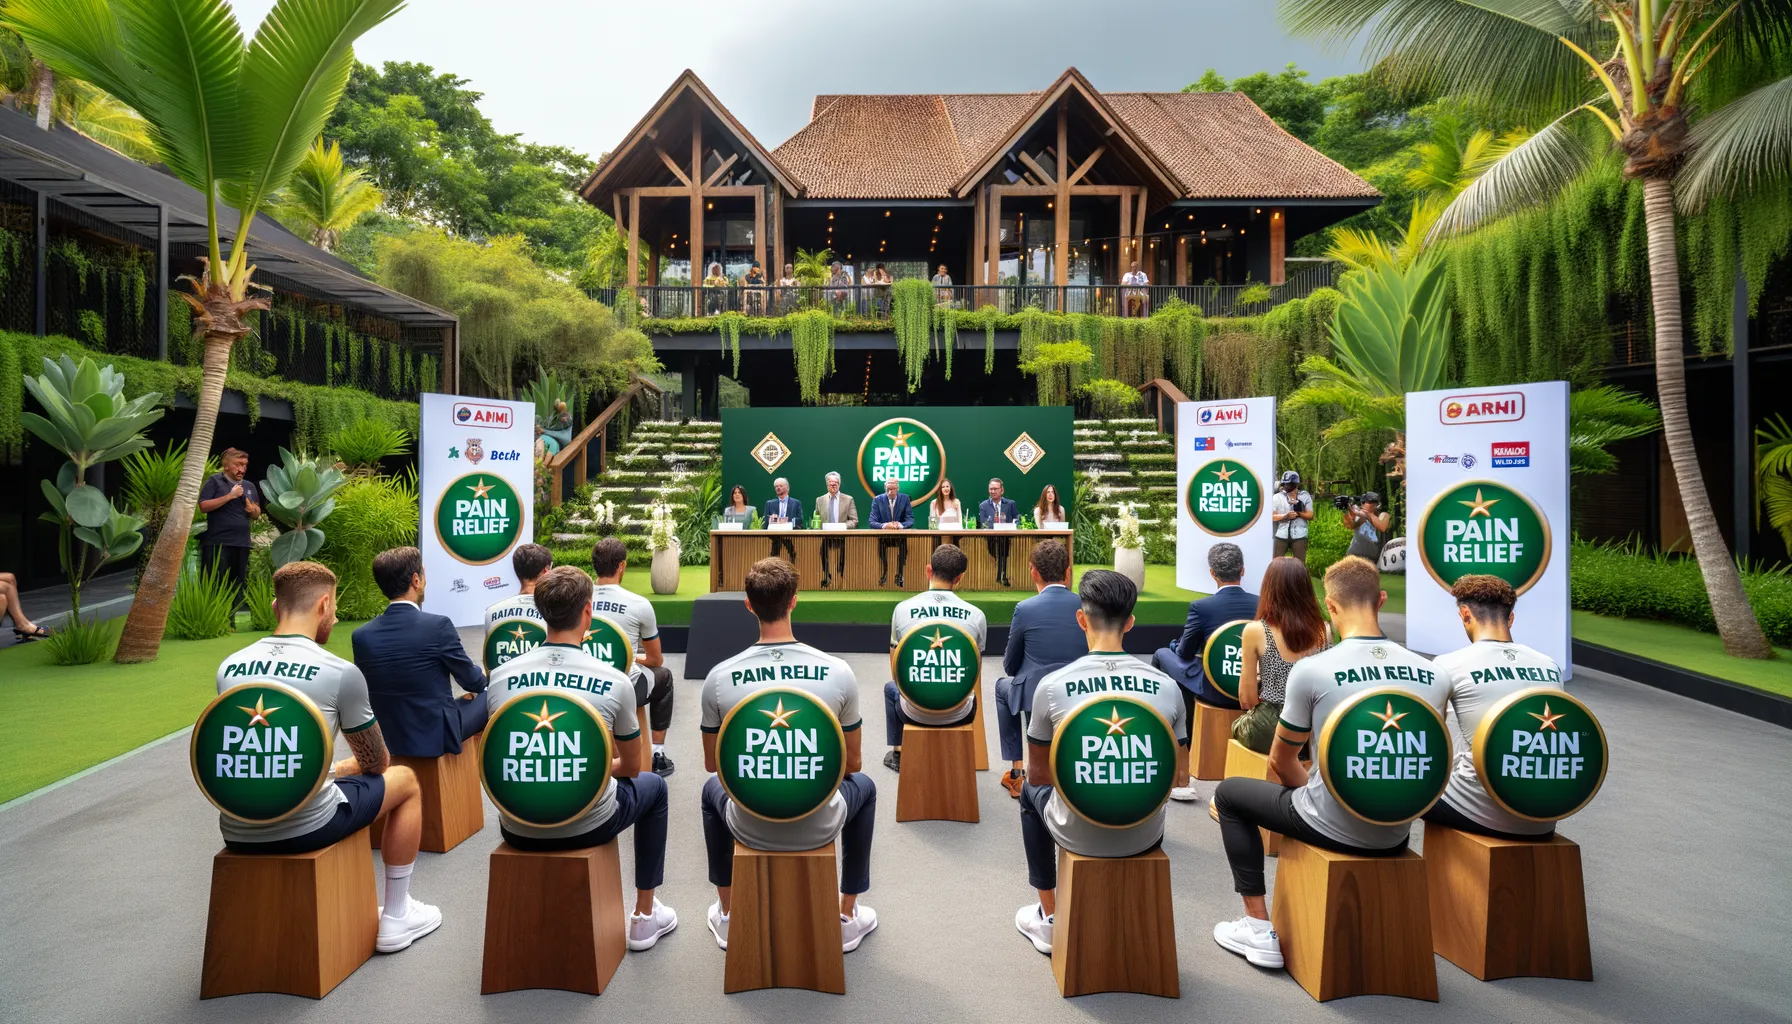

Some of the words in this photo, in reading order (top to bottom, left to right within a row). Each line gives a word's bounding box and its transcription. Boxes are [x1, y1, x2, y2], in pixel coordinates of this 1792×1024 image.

[1466, 400, 1516, 416] ARNI
[874, 445, 928, 465] PAIN
[872, 465, 930, 481] RELIEF
[1202, 480, 1248, 497] PAIN
[456, 498, 507, 518] PAIN
[1199, 497, 1252, 513] RELIEF
[453, 518, 510, 536] RELIEF
[1445, 518, 1519, 542] PAIN
[1443, 543, 1523, 563] RELIEF
[582, 643, 612, 659] AIN
[913, 649, 961, 666] PAIN
[1224, 644, 1243, 660] PA
[224, 660, 272, 679] PAIN
[731, 666, 776, 687] PAIN
[781, 665, 830, 681] RELIF
[909, 666, 966, 683] RELIEF
[1334, 666, 1381, 687] PAIN
[1470, 666, 1515, 685] PAIN
[507, 672, 550, 691] PAIN
[553, 672, 613, 696] RELIEF
[1065, 676, 1107, 697] PAIN
[1109, 675, 1160, 696] RELEF
[222, 725, 298, 753] PAIN
[508, 731, 581, 756] PAIN
[746, 728, 818, 754] PAIN
[1081, 734, 1153, 760] PAIN
[1357, 729, 1427, 755] PAIN
[1511, 729, 1580, 755] PAIN
[215, 753, 303, 779] RELIEF
[502, 757, 588, 783] RELIEF
[738, 754, 824, 780] RELIEF
[1074, 760, 1158, 784] RELIEF
[1346, 755, 1433, 780] RELIEF
[1501, 754, 1584, 780] RELIEF
